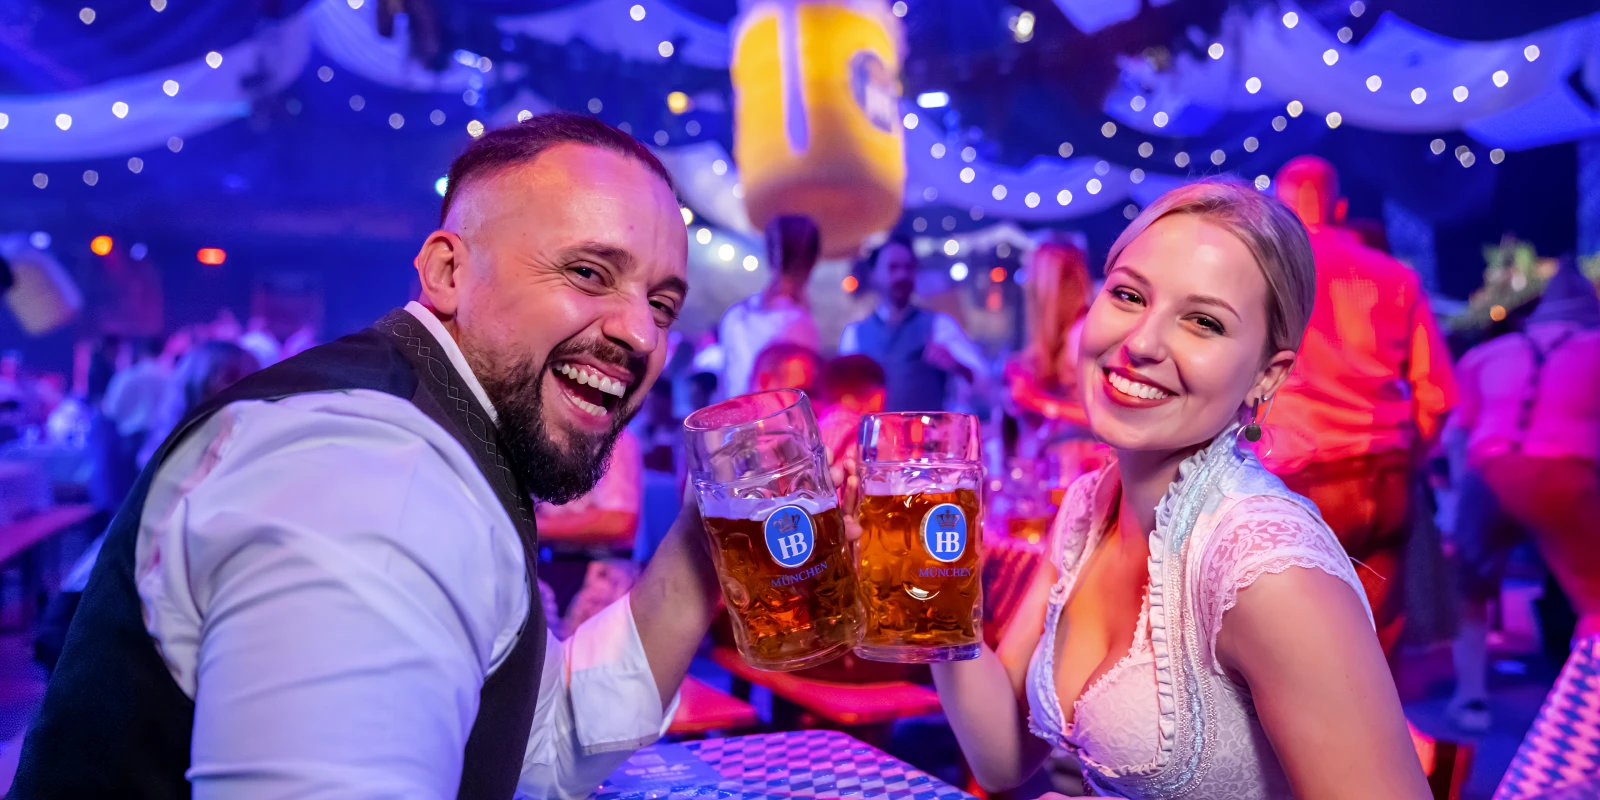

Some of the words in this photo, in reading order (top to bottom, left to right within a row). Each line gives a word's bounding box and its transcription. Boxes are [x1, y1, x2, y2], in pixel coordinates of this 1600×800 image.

[777, 532, 808, 560] HB
[935, 531, 960, 553] HB
[771, 560, 829, 587] MÜNCHEN
[919, 566, 971, 578] MÜNCHEN
